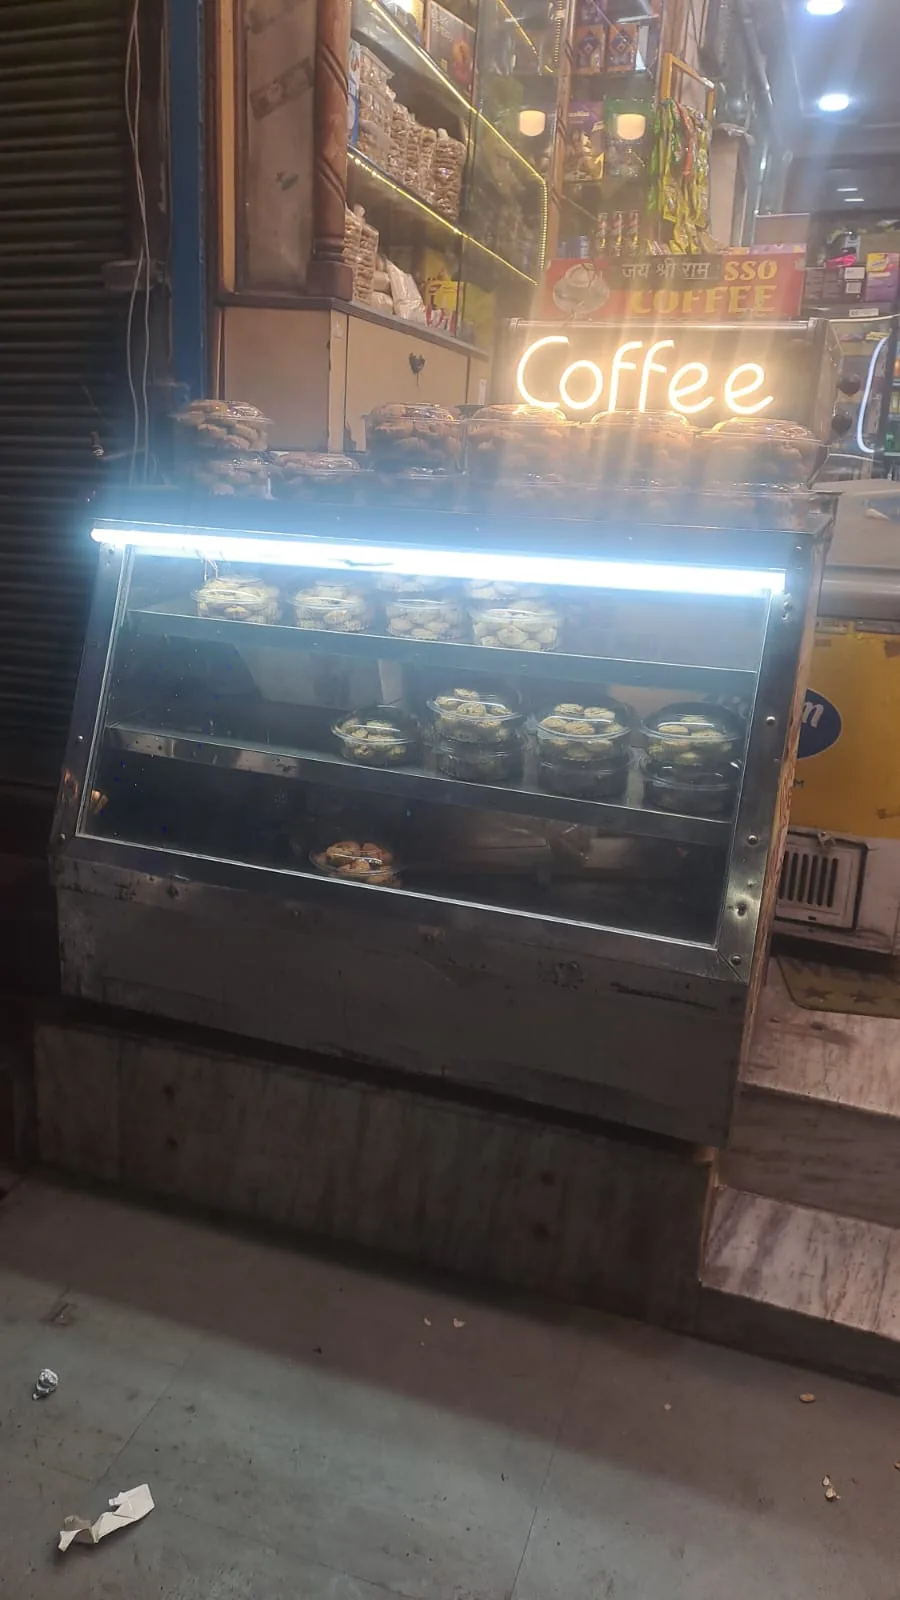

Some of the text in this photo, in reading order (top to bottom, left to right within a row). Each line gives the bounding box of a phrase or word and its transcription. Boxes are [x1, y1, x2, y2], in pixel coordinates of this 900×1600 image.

[622, 257, 711, 280] जय श्री राम
[724, 260, 778, 281] SSO
[630, 285, 777, 314] COFFEE
[516, 335, 775, 414] Coffee
